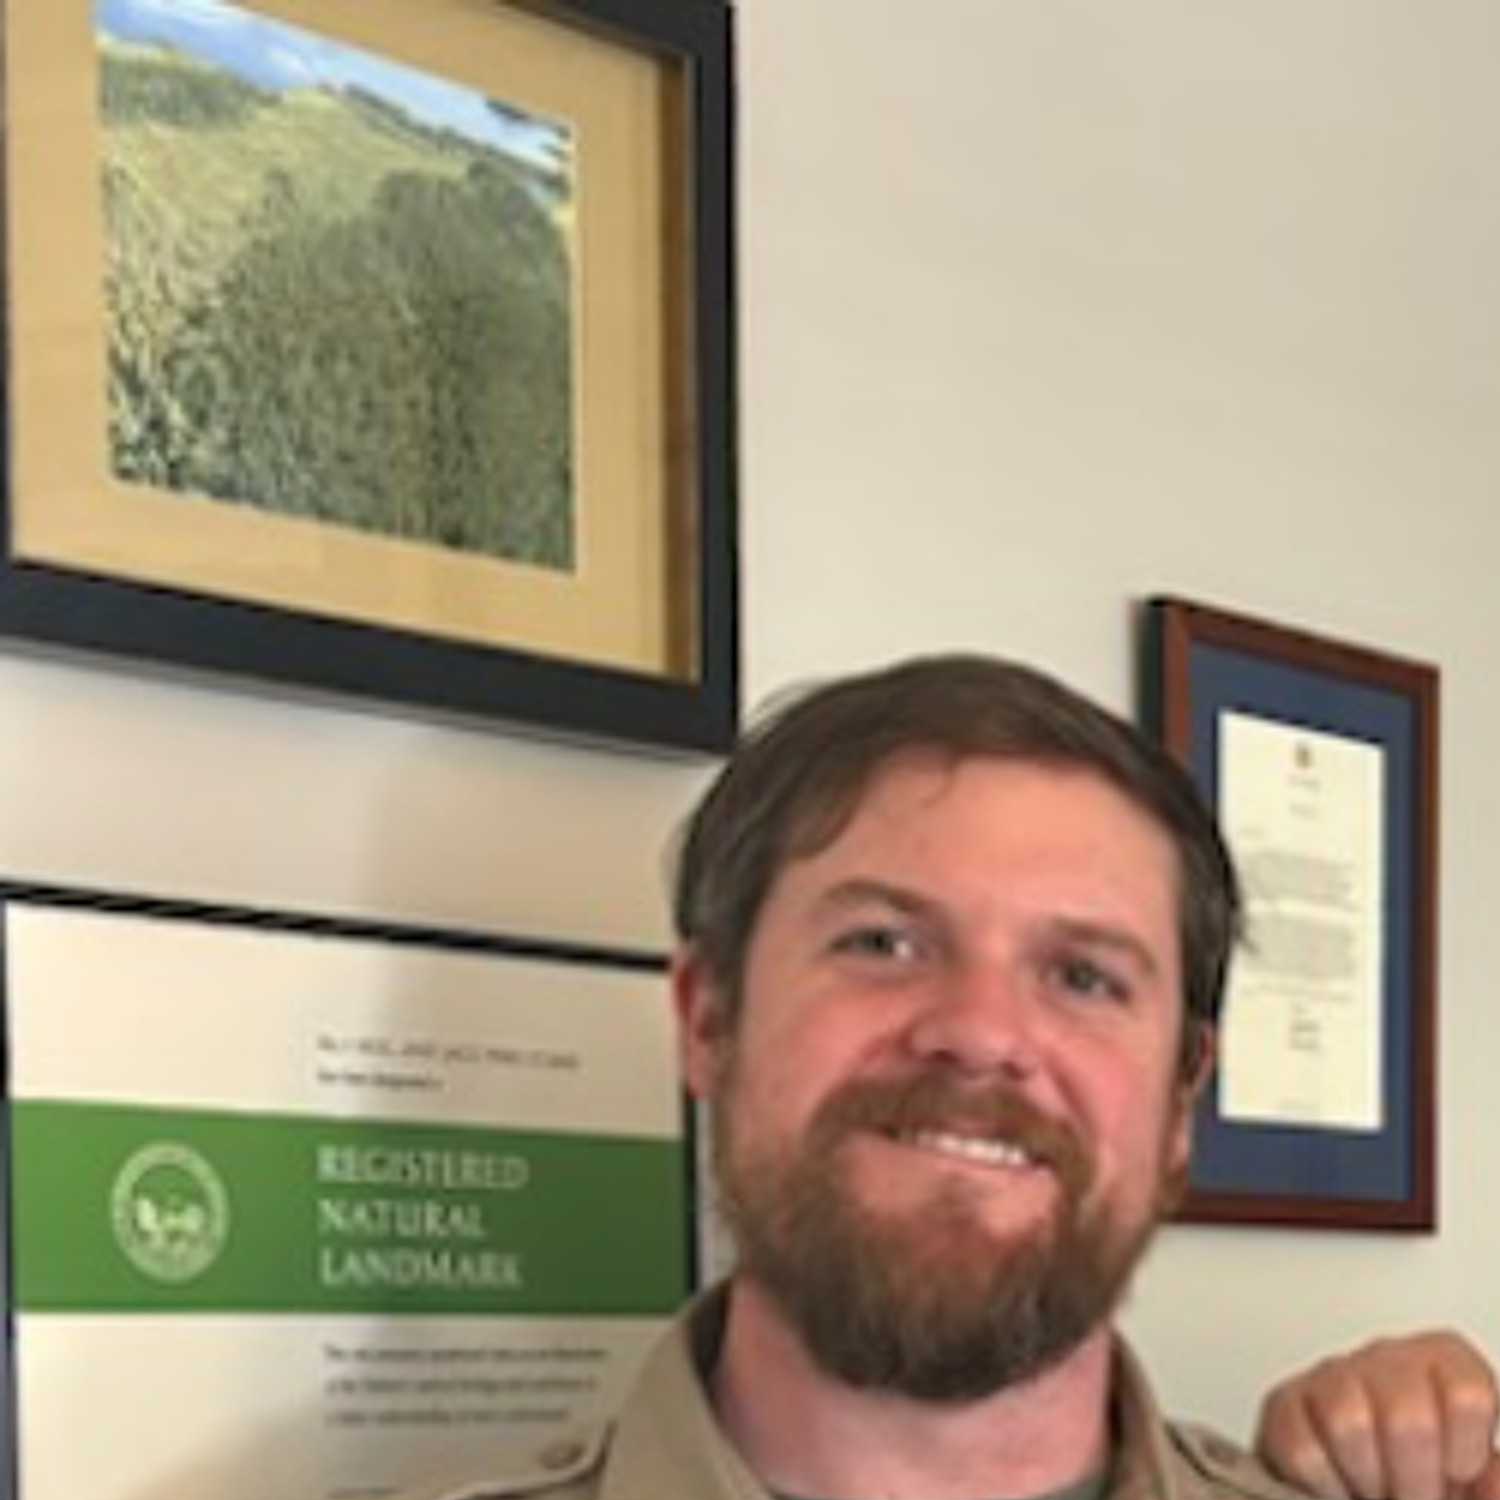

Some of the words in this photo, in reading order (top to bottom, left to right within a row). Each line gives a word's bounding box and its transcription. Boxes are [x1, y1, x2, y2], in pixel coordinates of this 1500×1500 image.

[315, 1145, 530, 1190] REGISTERED
[316, 1198, 487, 1238] NATURAL
[321, 1247, 525, 1287] LANDMARK
